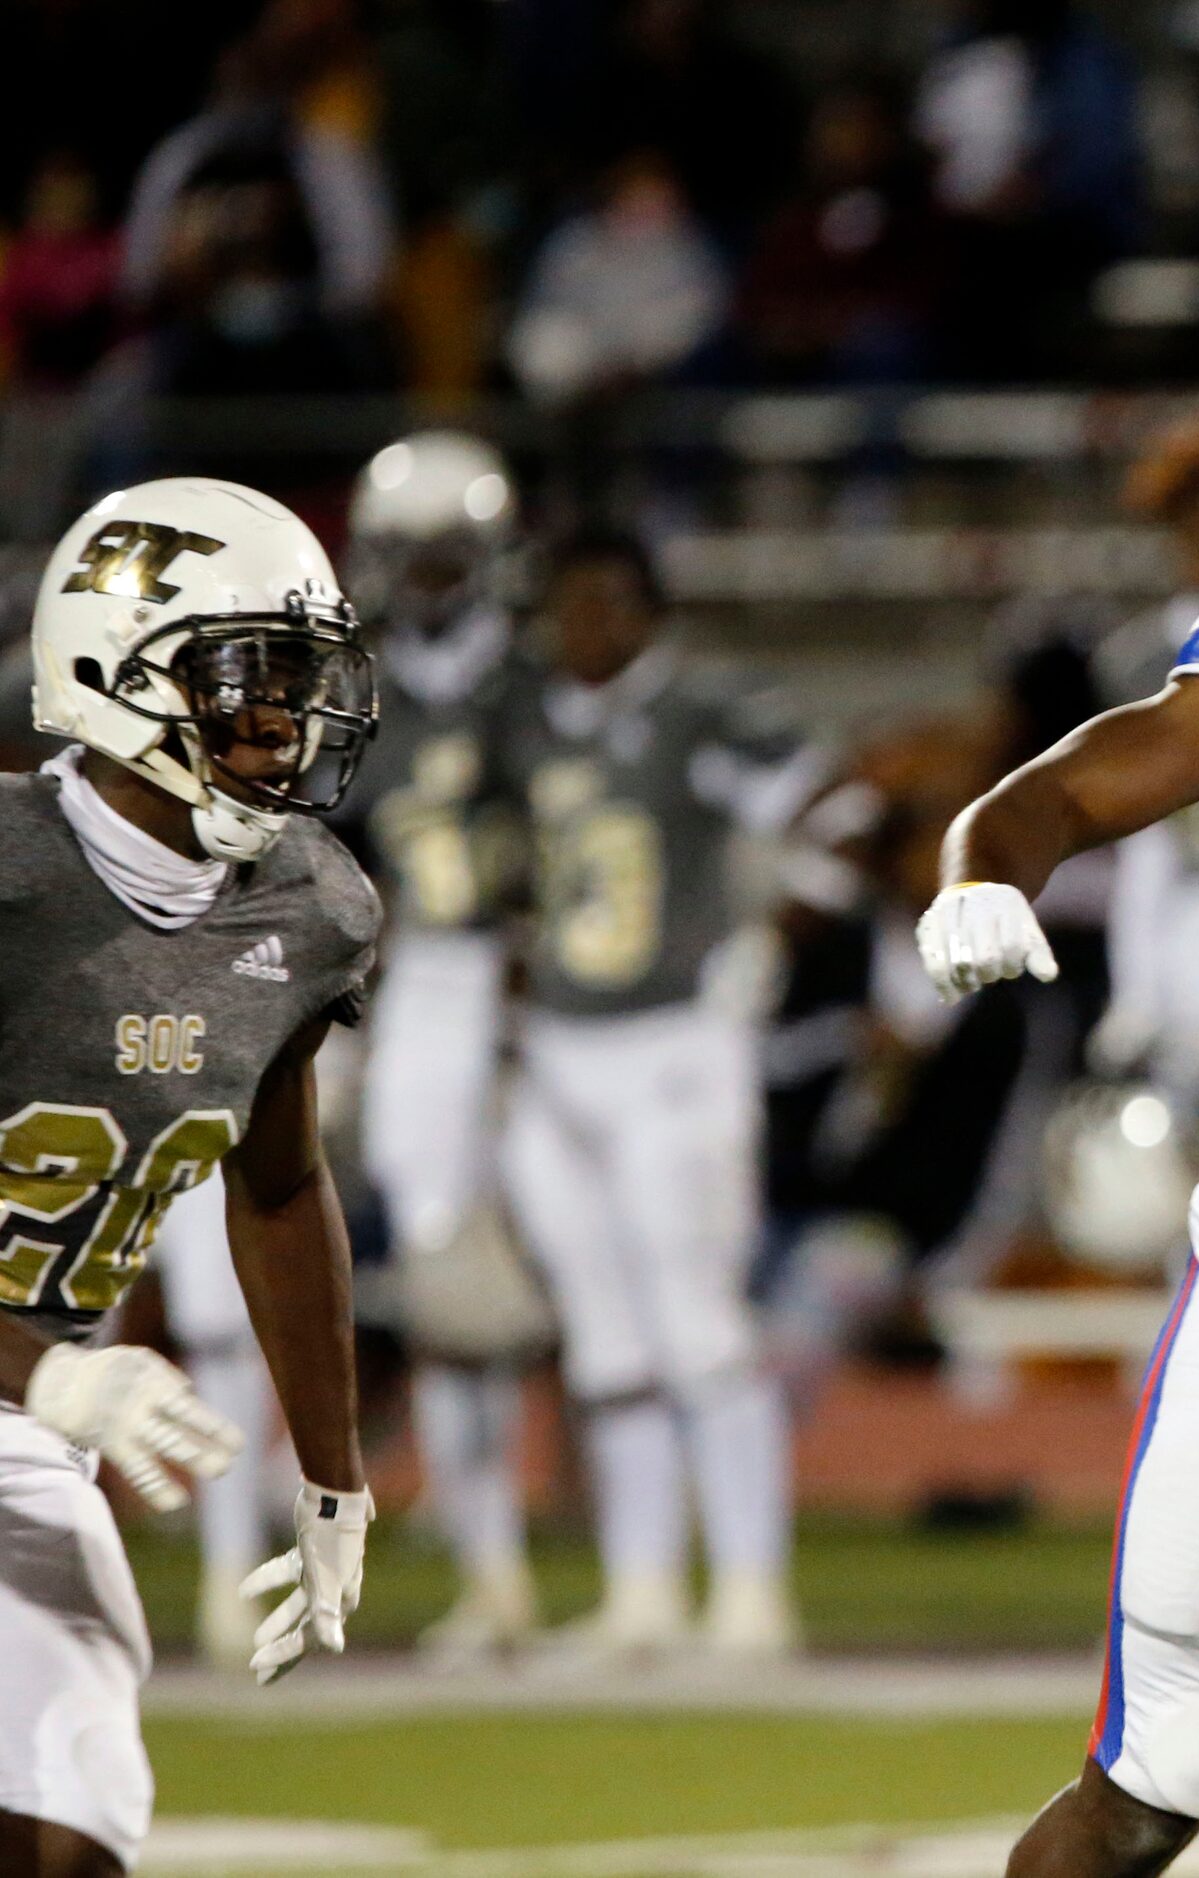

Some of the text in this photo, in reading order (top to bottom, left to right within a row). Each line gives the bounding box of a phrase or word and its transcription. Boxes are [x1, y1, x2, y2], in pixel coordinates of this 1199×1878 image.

[231, 960, 289, 982] adidas
[115, 1013, 207, 1075] SOC
[0, 1101, 240, 1309] 20
